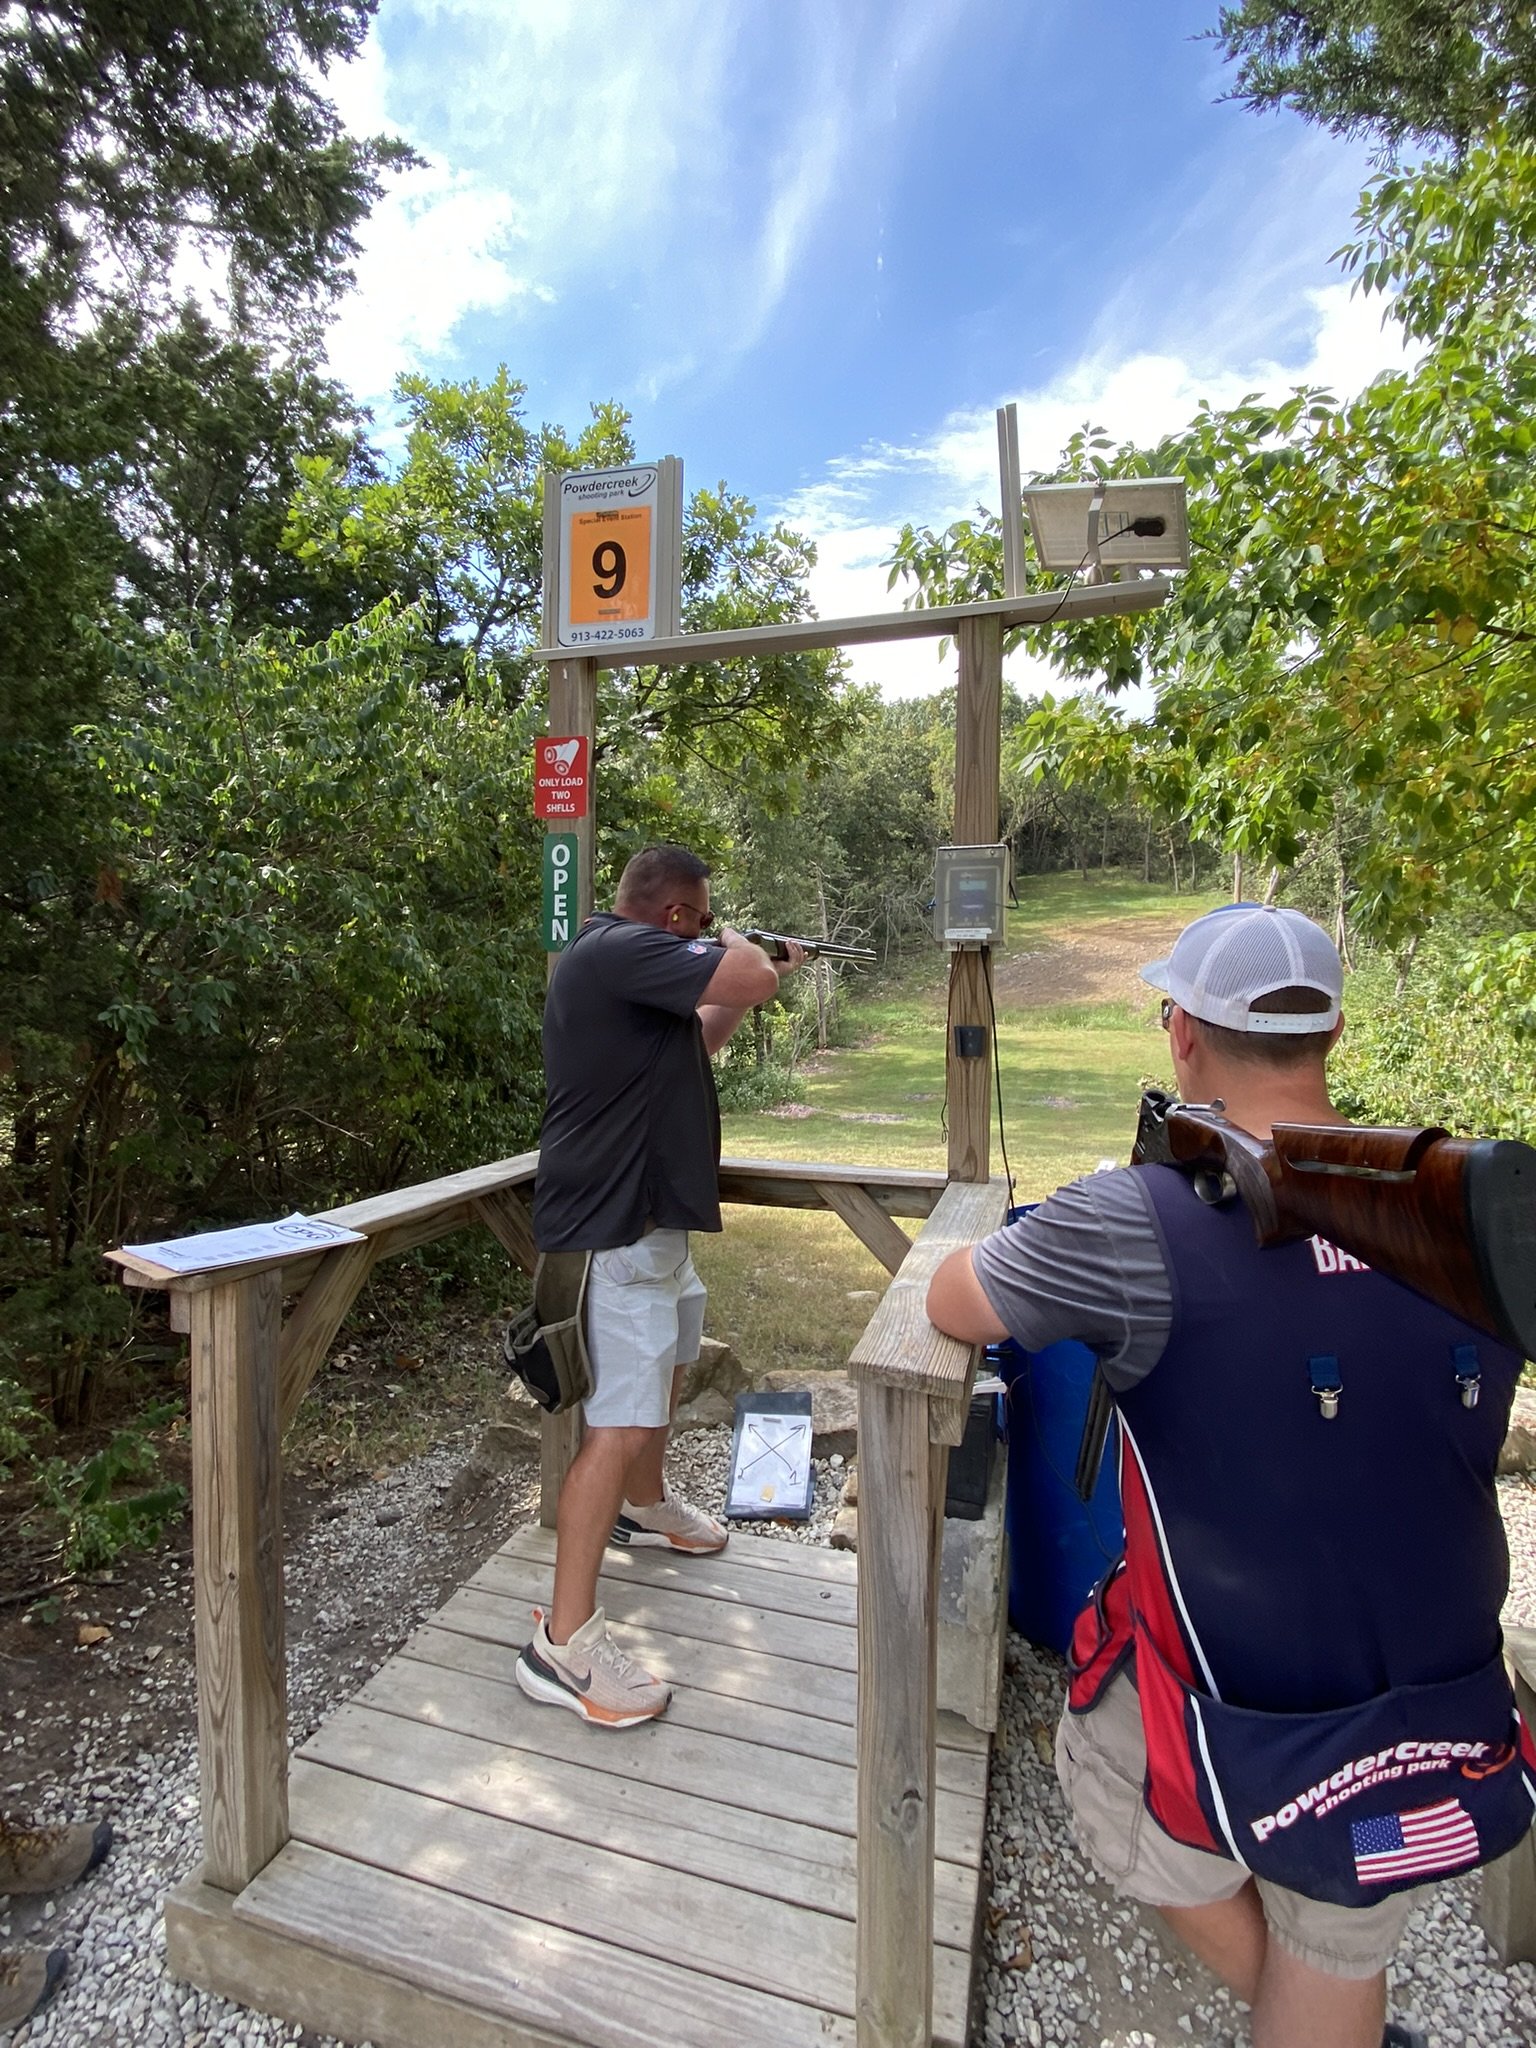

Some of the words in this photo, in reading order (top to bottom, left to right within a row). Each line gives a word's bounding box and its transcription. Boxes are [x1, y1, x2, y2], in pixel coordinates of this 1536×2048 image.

[564, 476, 639, 494] Powdercreek
[578, 491, 608, 501] shooting
[608, 489, 625, 499] park
[592, 540, 627, 599] 9
[571, 627, 645, 642] 913-422-5063
[539, 778, 560, 788] ONLY
[561, 777, 583, 787] LOAD
[551, 790, 570, 800] TWO
[546, 803, 576, 813] SHELLS
[551, 843, 571, 942] OPEN
[789, 1470, 802, 1486] 1
[1250, 1741, 1490, 1843] PowderCreek
[1315, 1765, 1403, 1819] shooting
[1406, 1758, 1452, 1778] park
